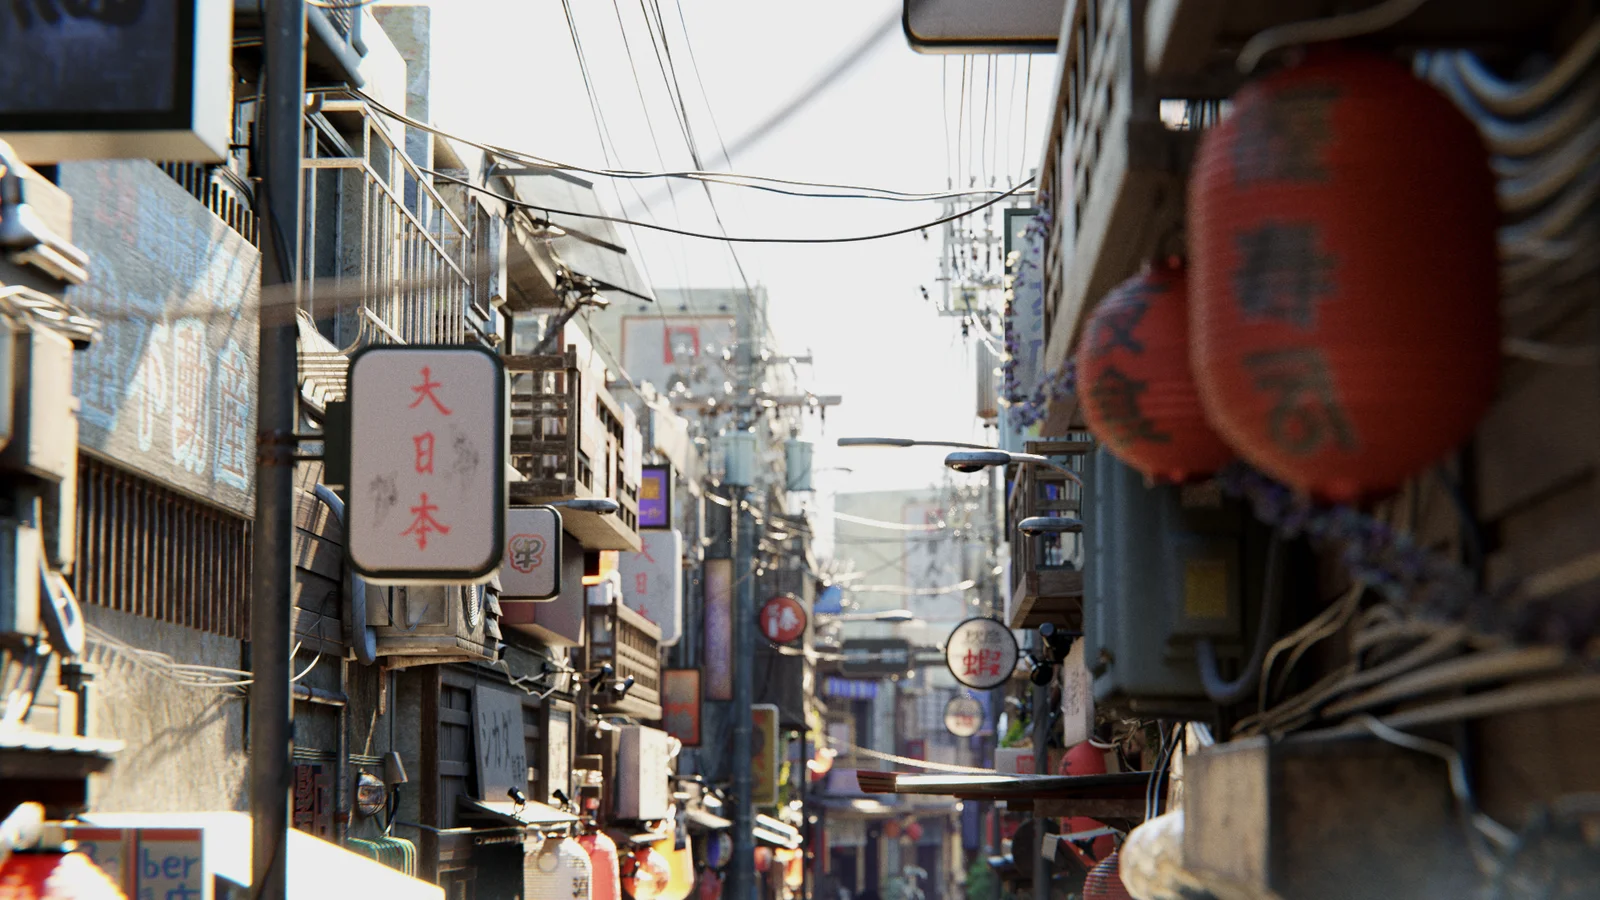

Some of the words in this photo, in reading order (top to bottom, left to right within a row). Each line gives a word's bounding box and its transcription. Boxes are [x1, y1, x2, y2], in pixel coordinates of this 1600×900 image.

[399, 364, 452, 551] 大日本
[143, 847, 199, 879] ber
